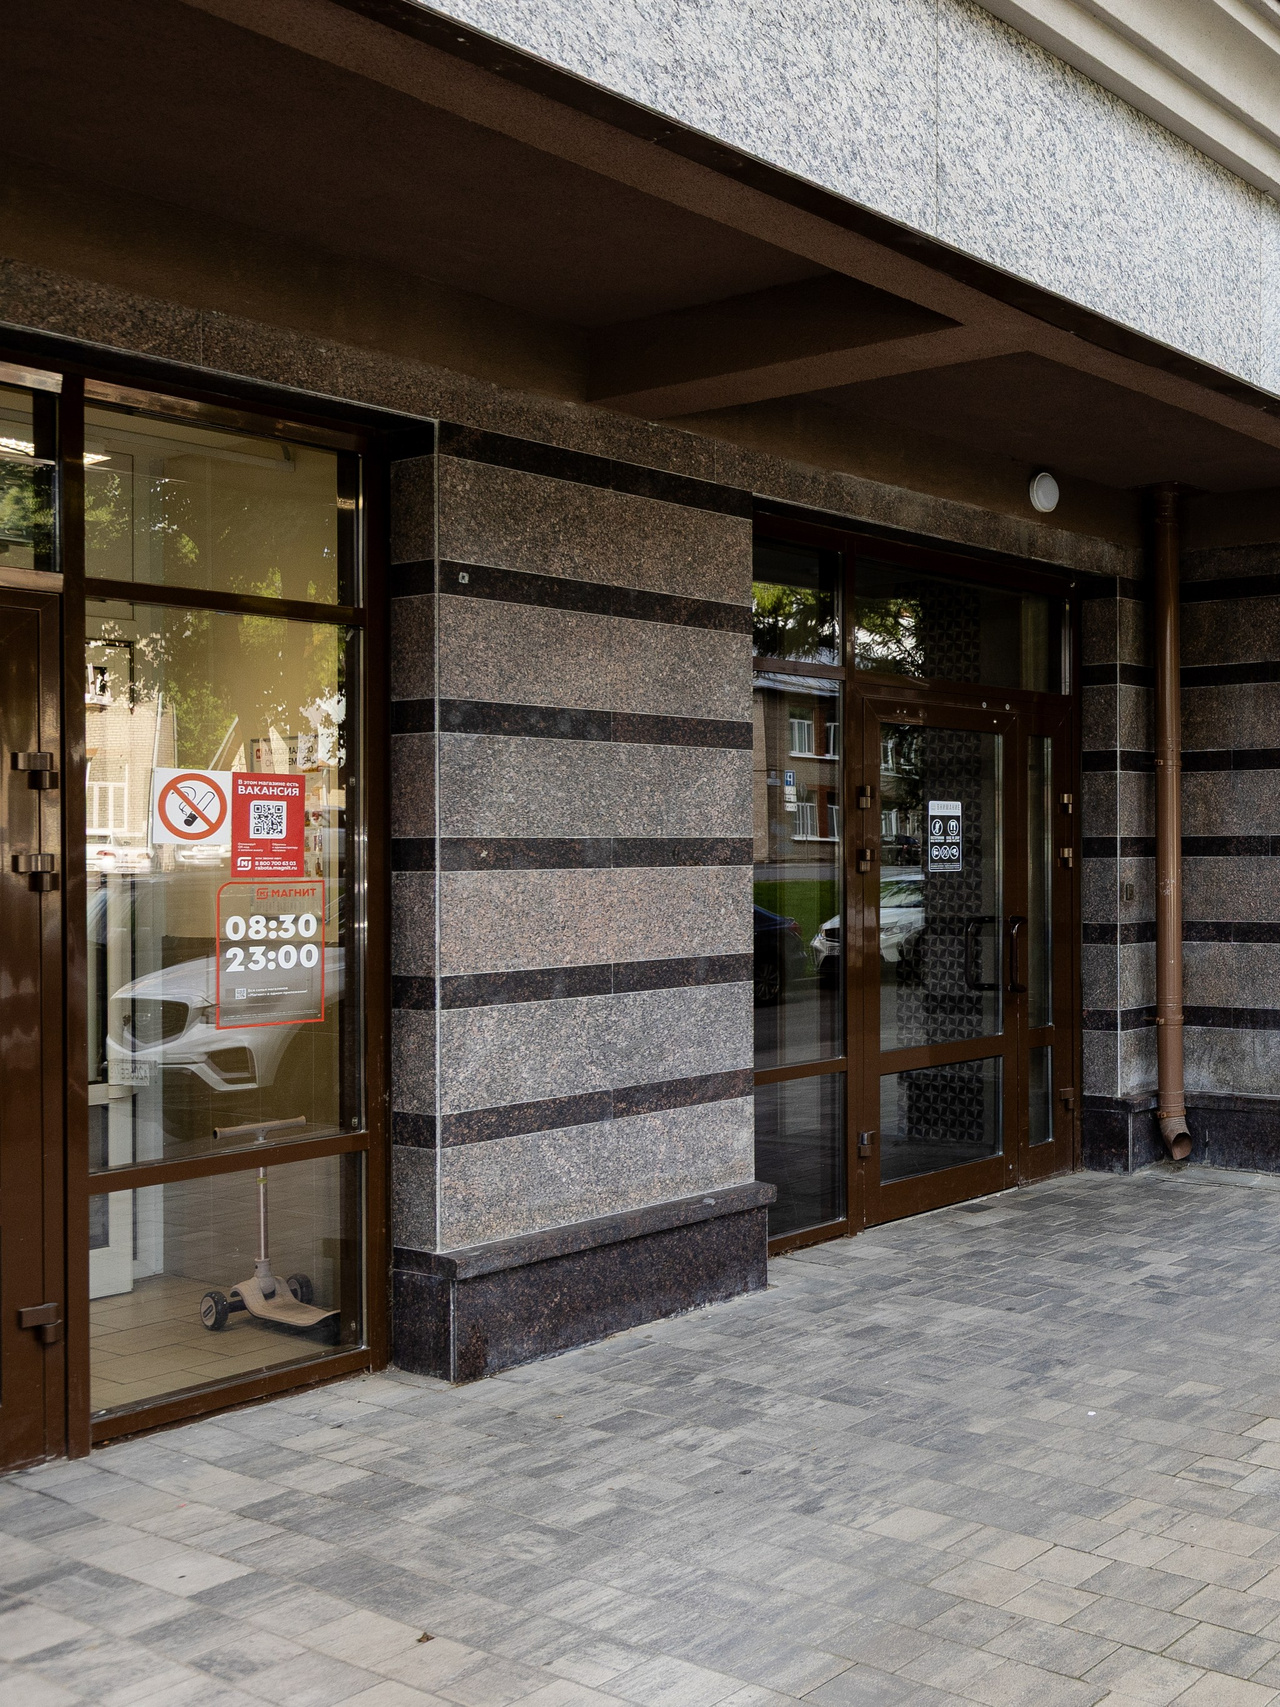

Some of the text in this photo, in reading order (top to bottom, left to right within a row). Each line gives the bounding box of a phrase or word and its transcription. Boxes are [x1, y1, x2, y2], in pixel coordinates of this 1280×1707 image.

[238, 785, 299, 796] ВАКАНСИЯ
[270, 888, 317, 898] МАГНИТ
[225, 913, 318, 941] 08:30
[225, 944, 319, 972] 23:00
